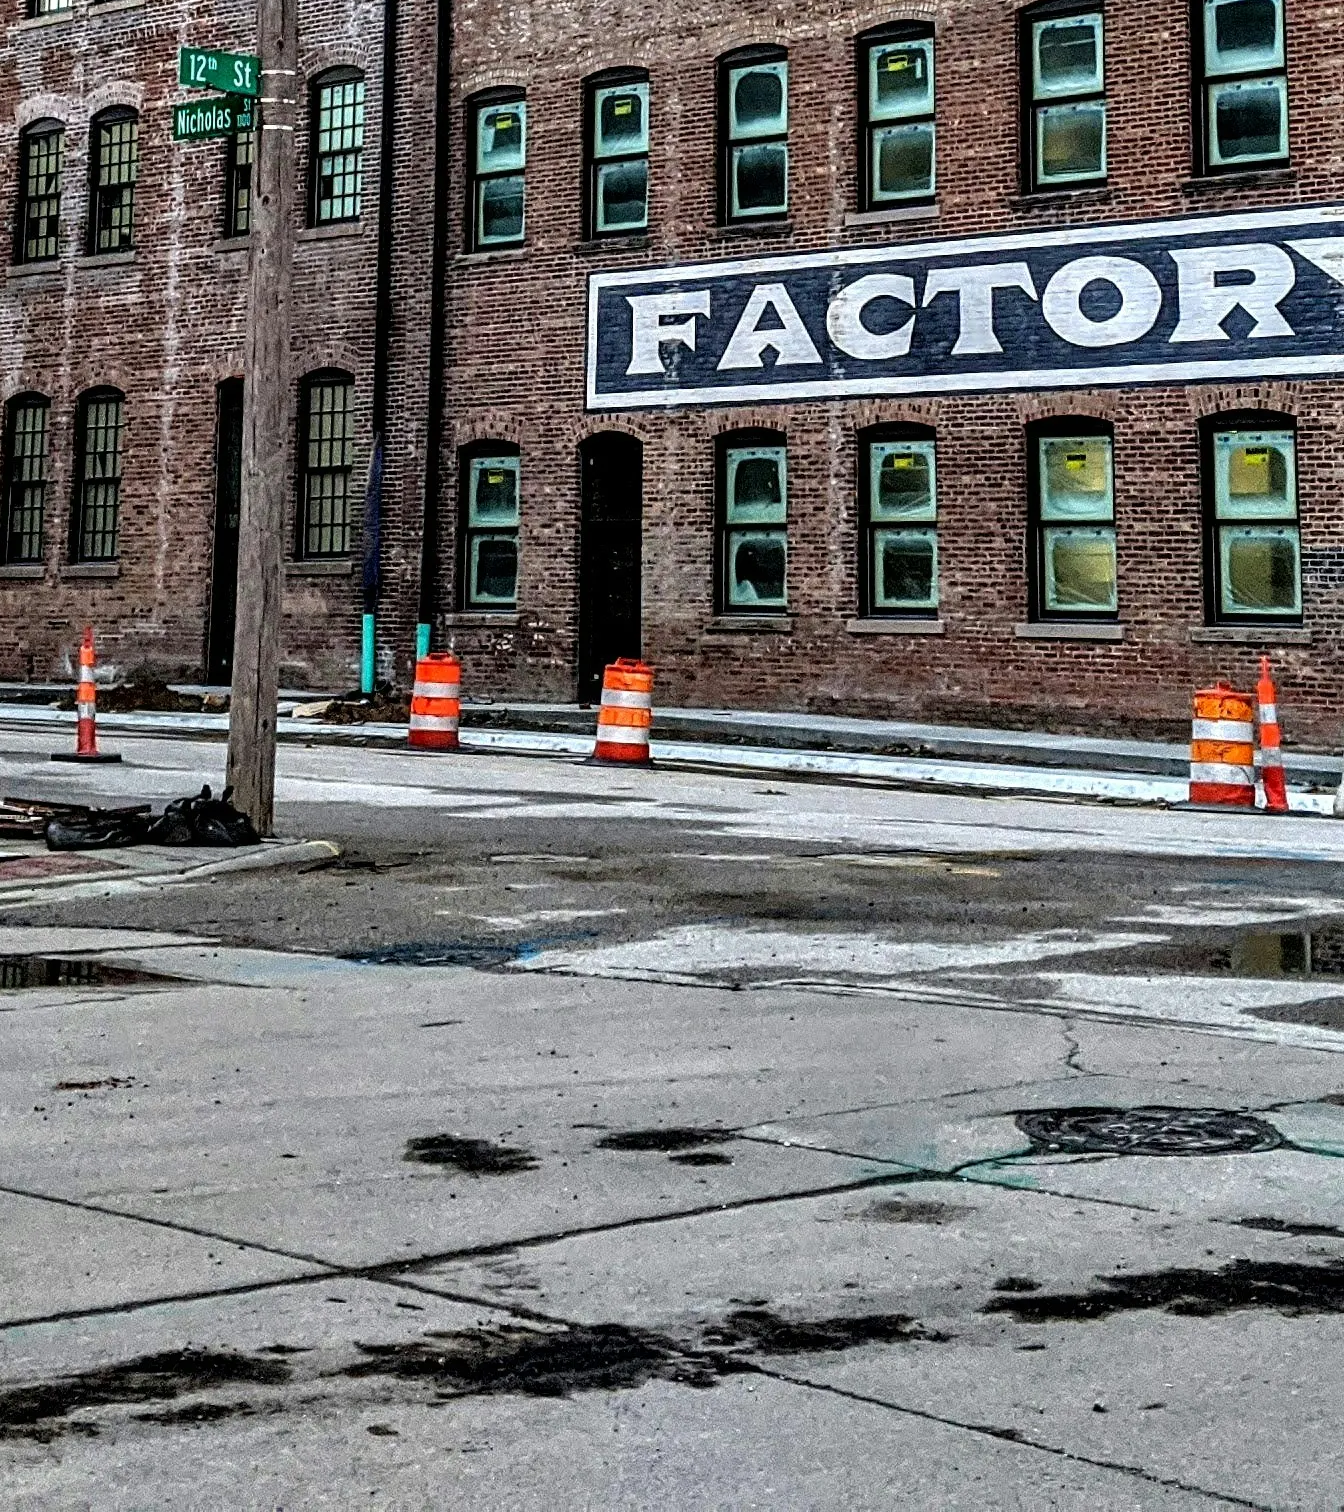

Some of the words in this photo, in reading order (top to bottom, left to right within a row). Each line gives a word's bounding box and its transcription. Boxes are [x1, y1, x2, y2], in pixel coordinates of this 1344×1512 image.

[189, 53, 218, 82] 12th
[233, 59, 252, 88] St
[176, 105, 231, 136] Nicholas
